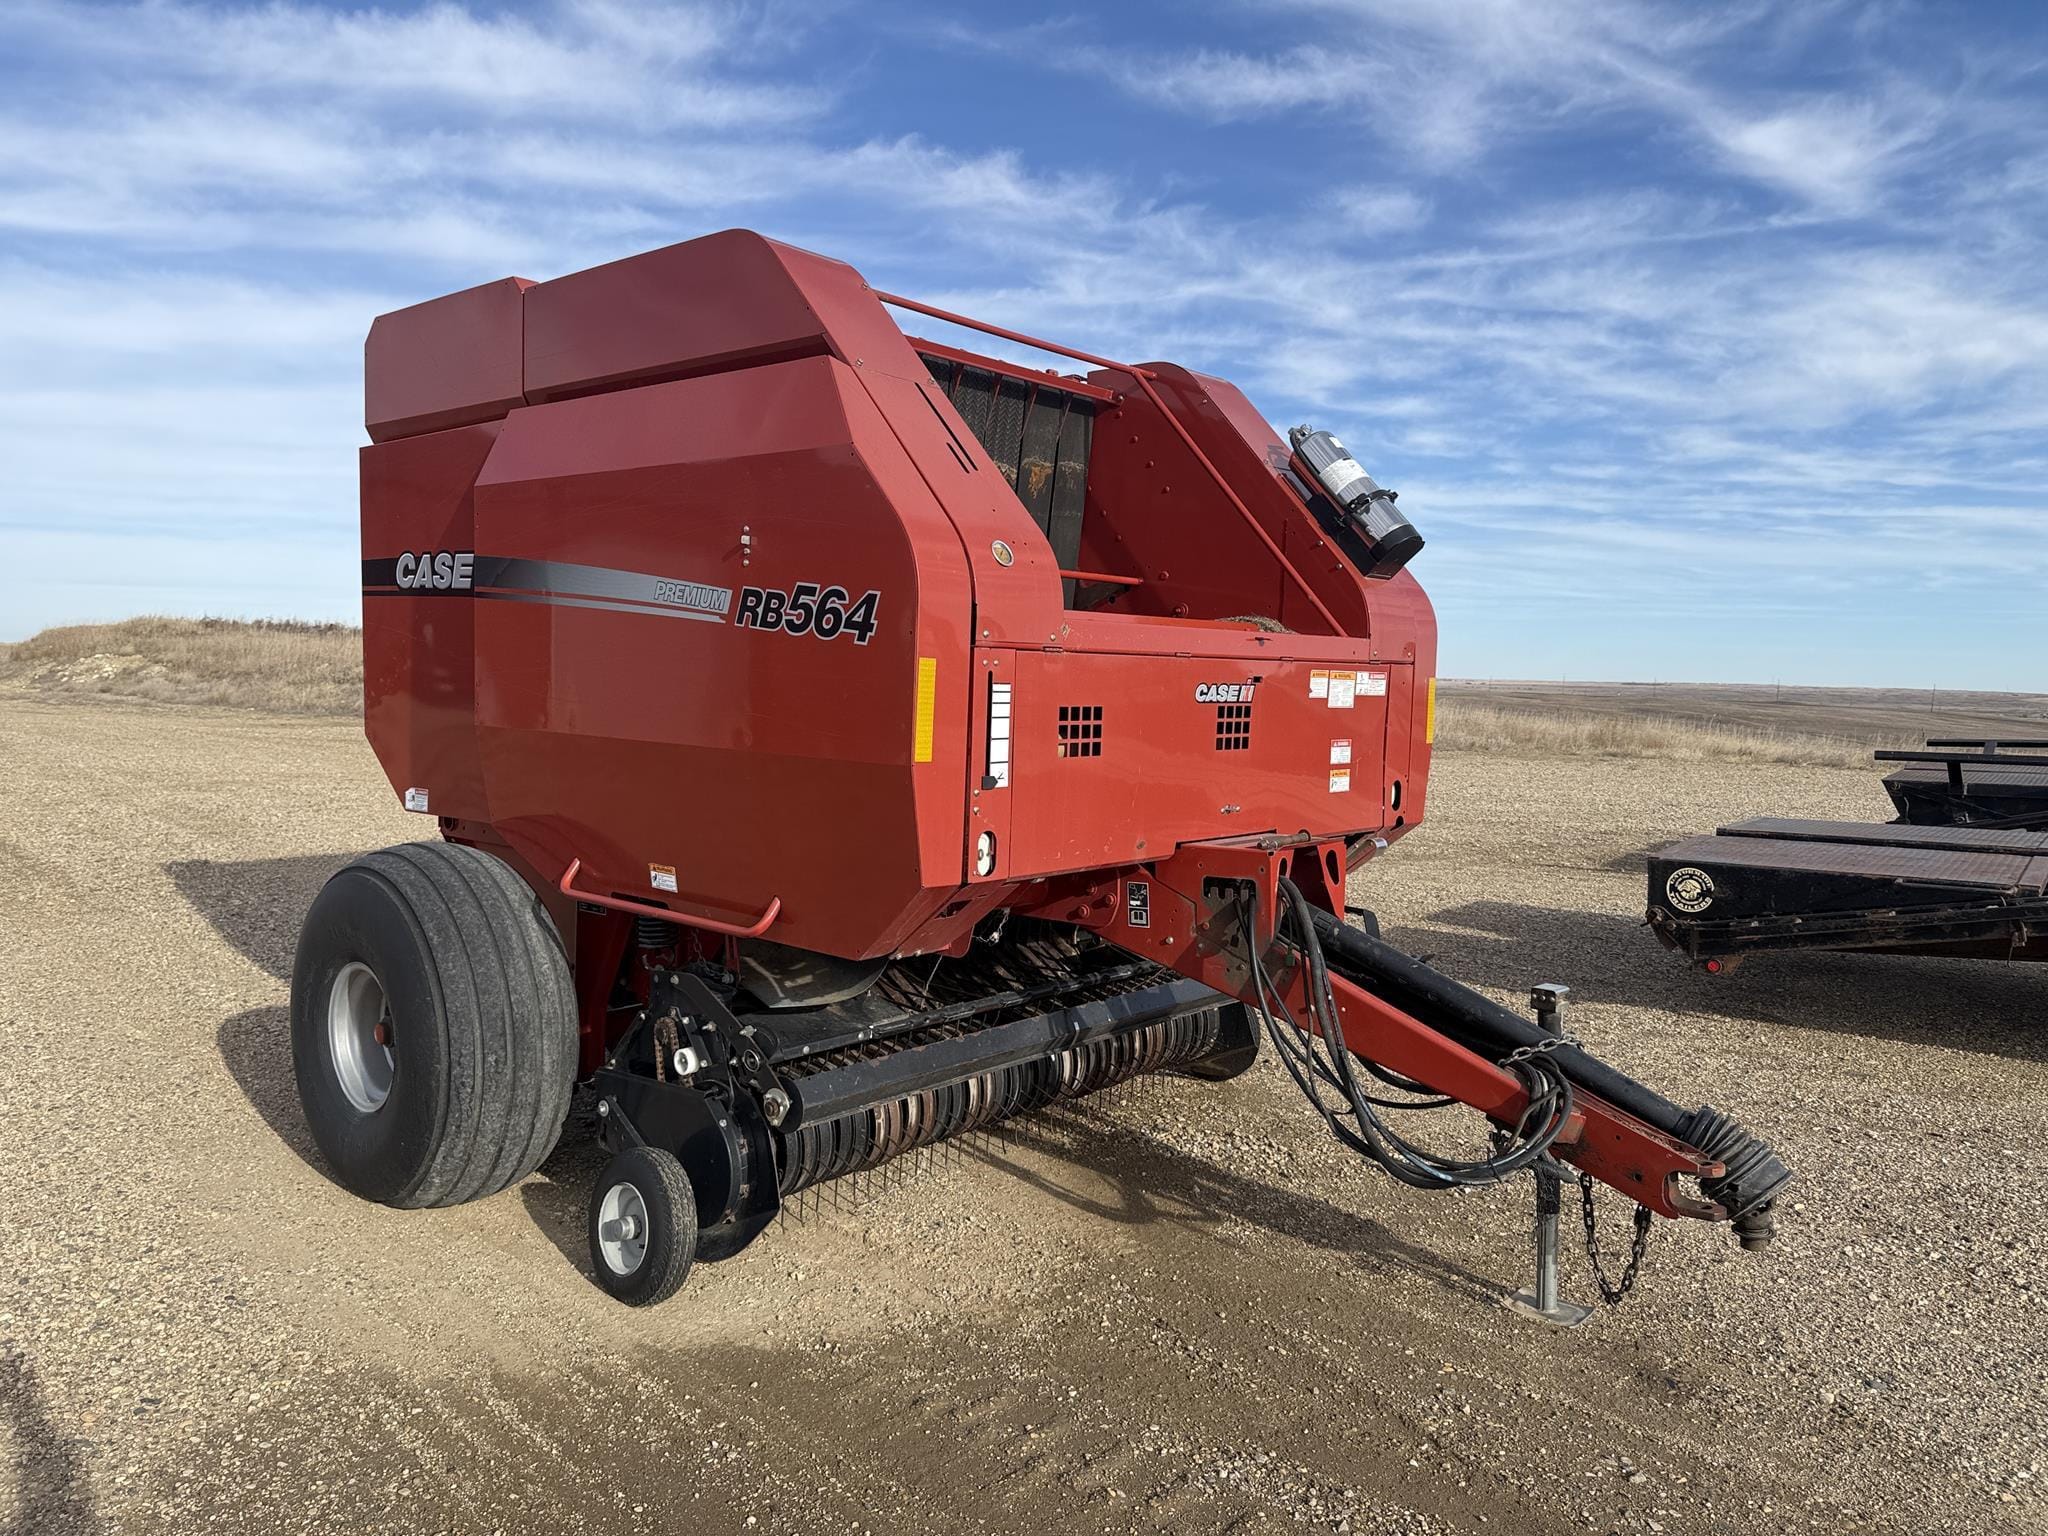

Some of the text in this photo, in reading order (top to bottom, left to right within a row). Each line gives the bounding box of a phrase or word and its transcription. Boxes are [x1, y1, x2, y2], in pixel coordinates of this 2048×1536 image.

[395, 552, 475, 590] CASE
[654, 579, 881, 646] PREMIUM RB564
[1669, 890, 1713, 910] TRAILERS
